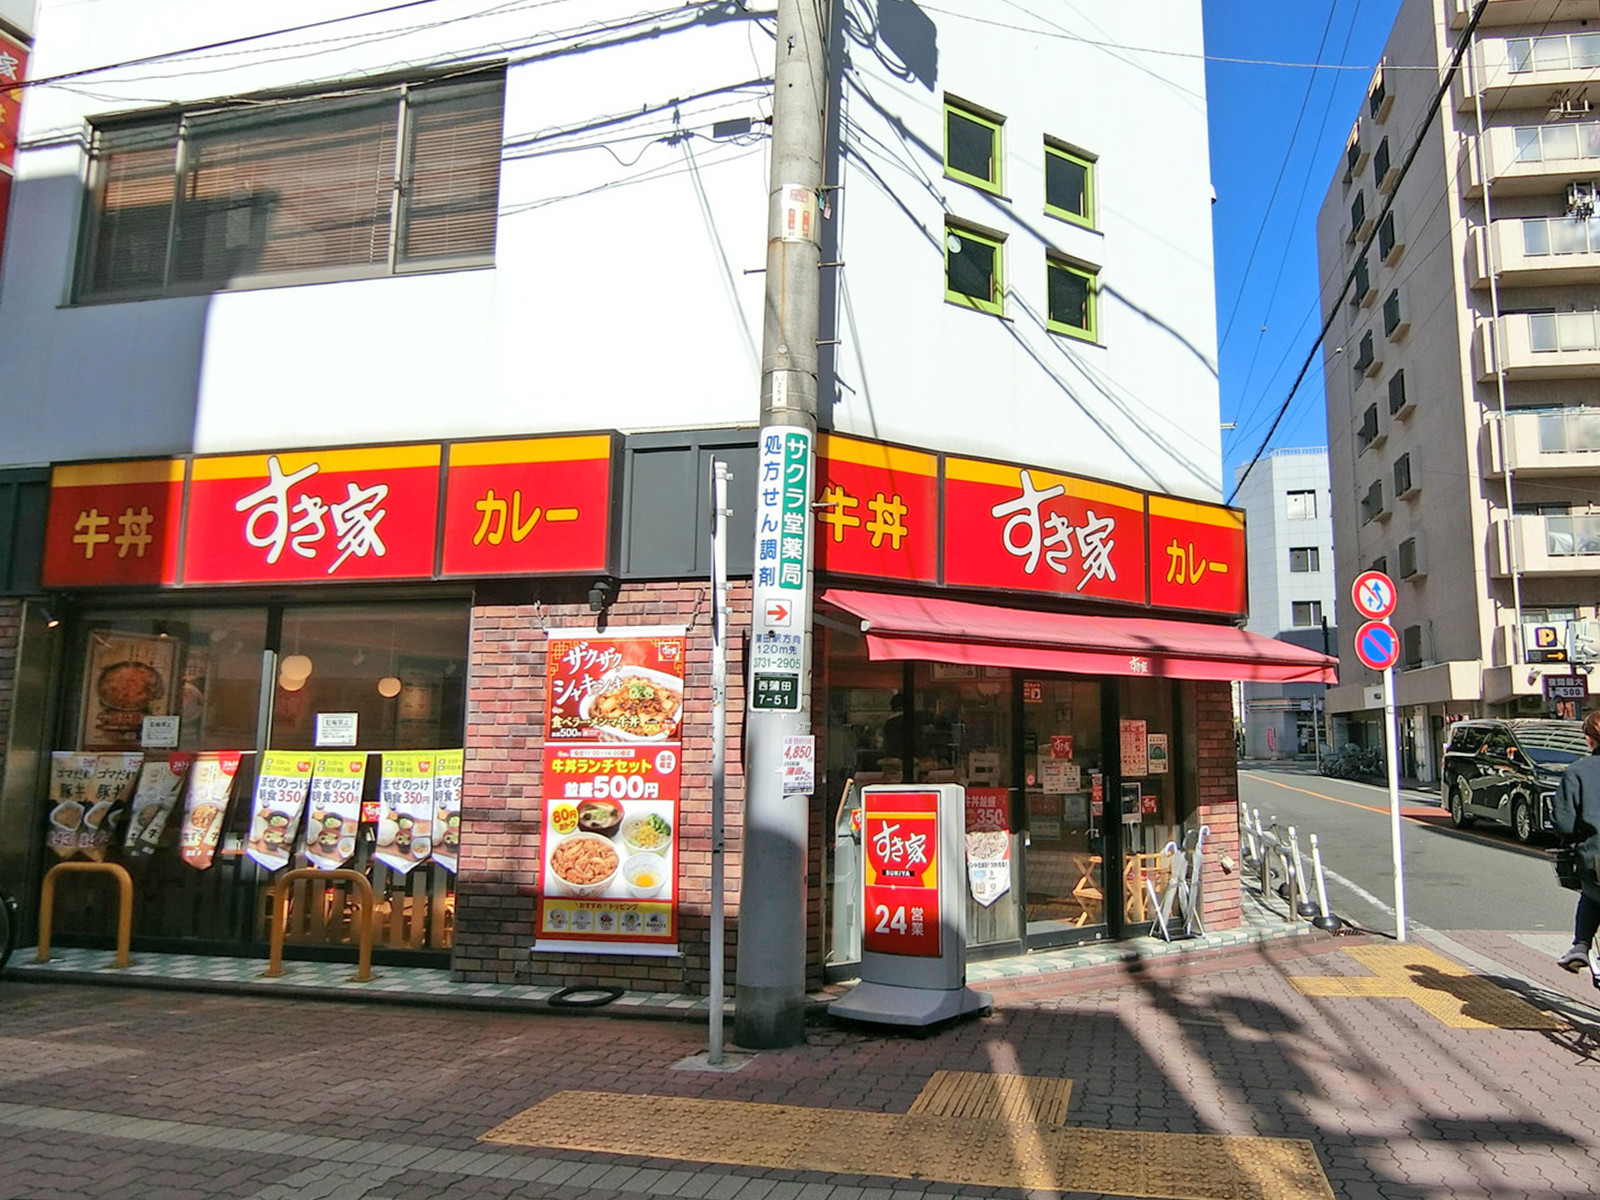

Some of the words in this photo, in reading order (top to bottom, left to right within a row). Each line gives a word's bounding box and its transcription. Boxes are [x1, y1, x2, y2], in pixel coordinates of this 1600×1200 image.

[73, 506, 154, 560] 牛丼
[235, 455, 389, 574] すき家
[473, 489, 580, 547] カレー
[759, 435, 782, 588] 処方せん調剤
[781, 437, 807, 586] サクラ堂薬局
[818, 485, 909, 551] 牛丼
[991, 468, 1118, 591] すき家
[1165, 539, 1229, 586] カレー
[753, 657, 802, 669] 3731-2905
[260, 777, 310, 791] まぜのっけ
[312, 778, 361, 791] まぜのっけ
[383, 779, 431, 791] まぜのっけ
[551, 759, 653, 774] 牛丼ランチセット
[384, 791, 431, 805] 朝食350円
[872, 820, 927, 869] すき家
[885, 869, 911, 877] SUKIYA
[874, 904, 907, 936] 24
[911, 906, 924, 936] 営業
